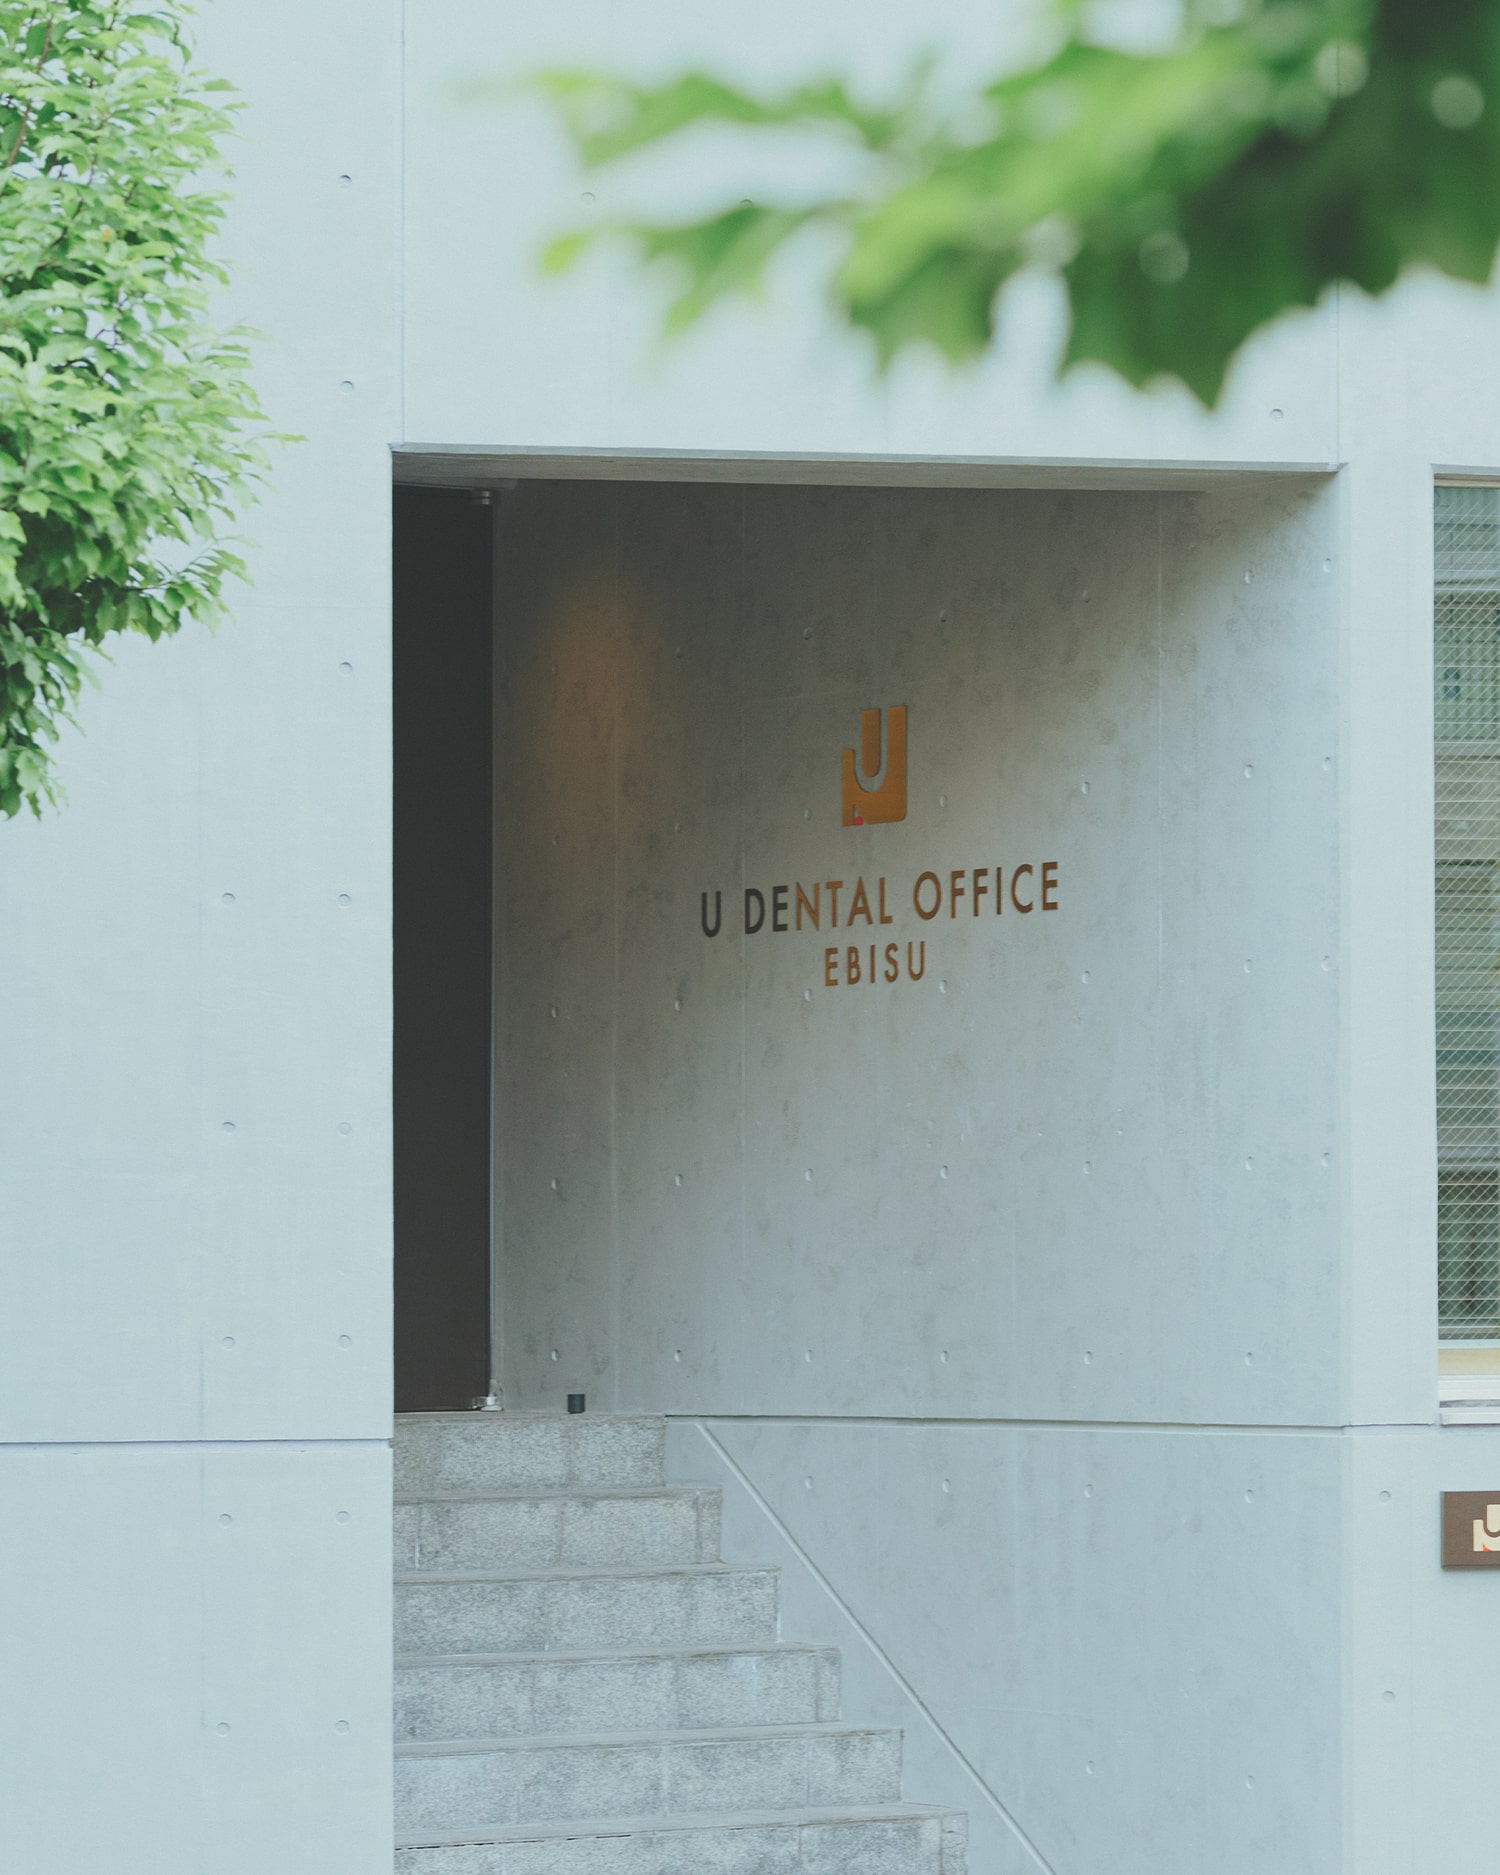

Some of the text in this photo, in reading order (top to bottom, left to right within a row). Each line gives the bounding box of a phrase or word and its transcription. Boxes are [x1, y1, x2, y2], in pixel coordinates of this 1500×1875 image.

[701, 861, 1059, 938] U DENTAL OFFICE
[824, 940, 926, 986] EBISU
